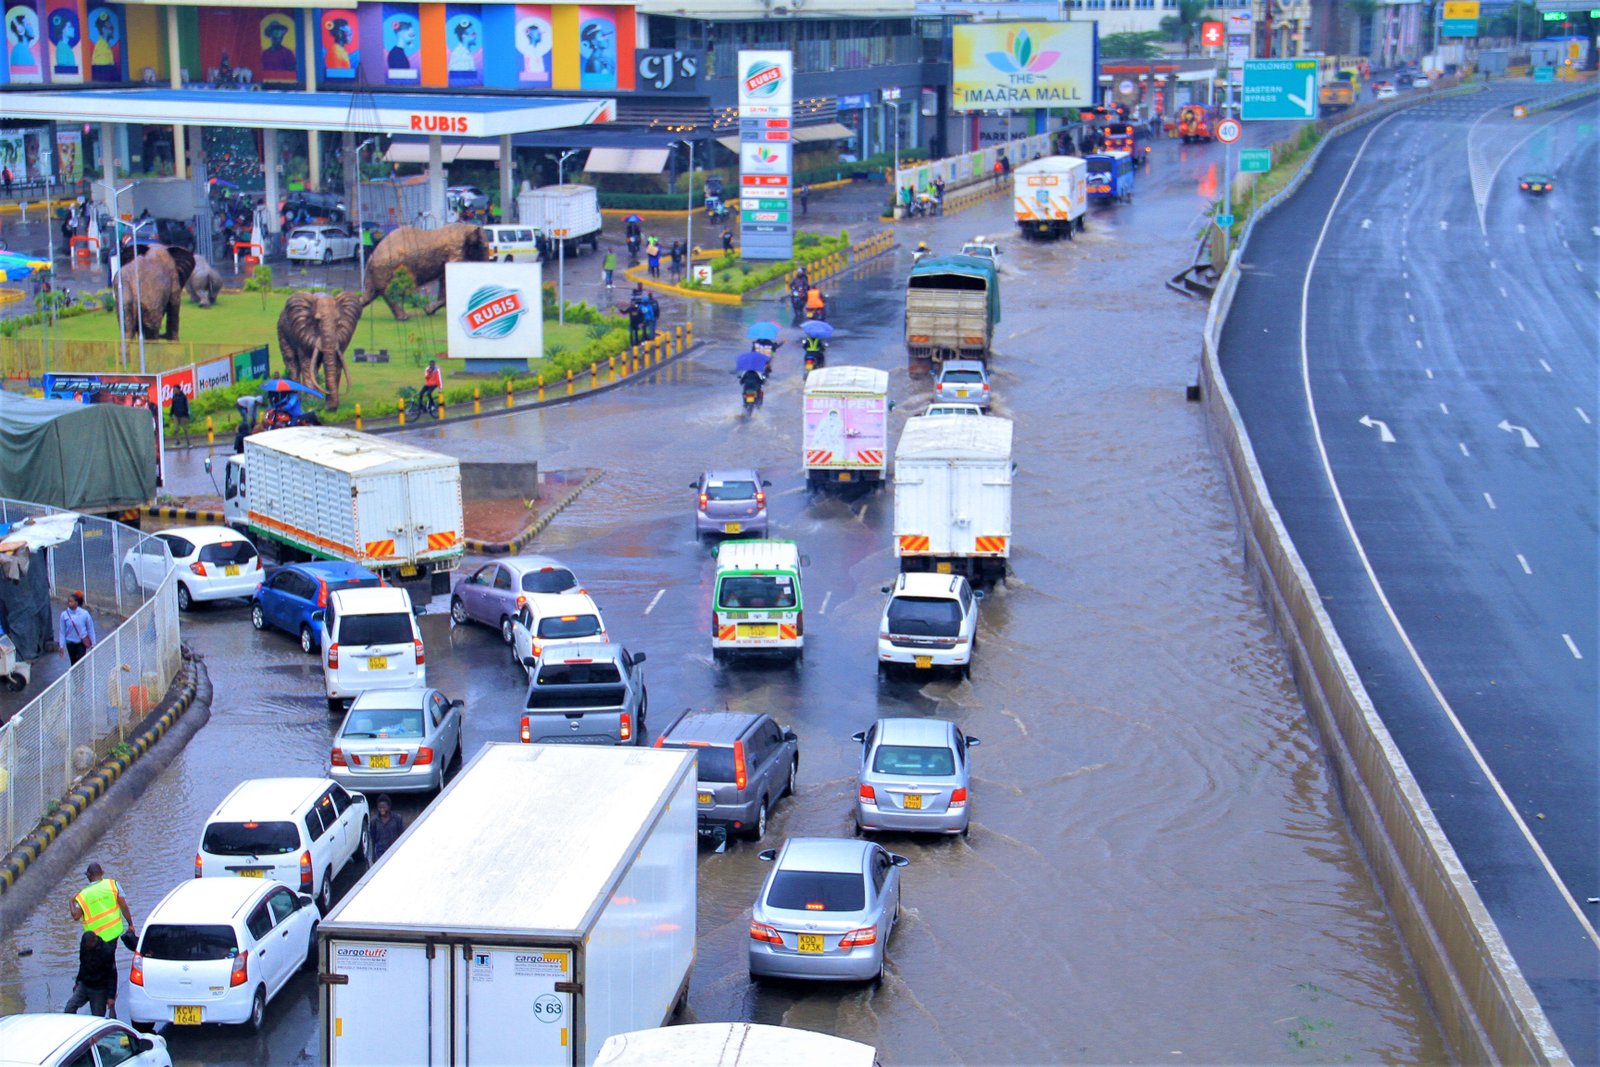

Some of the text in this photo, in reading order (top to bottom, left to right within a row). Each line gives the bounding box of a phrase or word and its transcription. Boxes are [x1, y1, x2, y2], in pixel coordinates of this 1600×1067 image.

[1245, 62, 1293, 70] MLOLONGO
[1009, 74, 1035, 84] THE
[965, 87, 1082, 102] IMAARA MALL
[1221, 126, 1236, 137] 40
[981, 132, 1028, 141] PARKNG
[200, 373, 229, 391] Hotpoint
[800, 934, 817, 943] KDD
[800, 943, 821, 951] 473K
[337, 948, 384, 958] cargotuff
[177, 1006, 194, 1015] KCV
[535, 1002, 562, 1014] S 63
[177, 1014, 198, 1023] 164L
